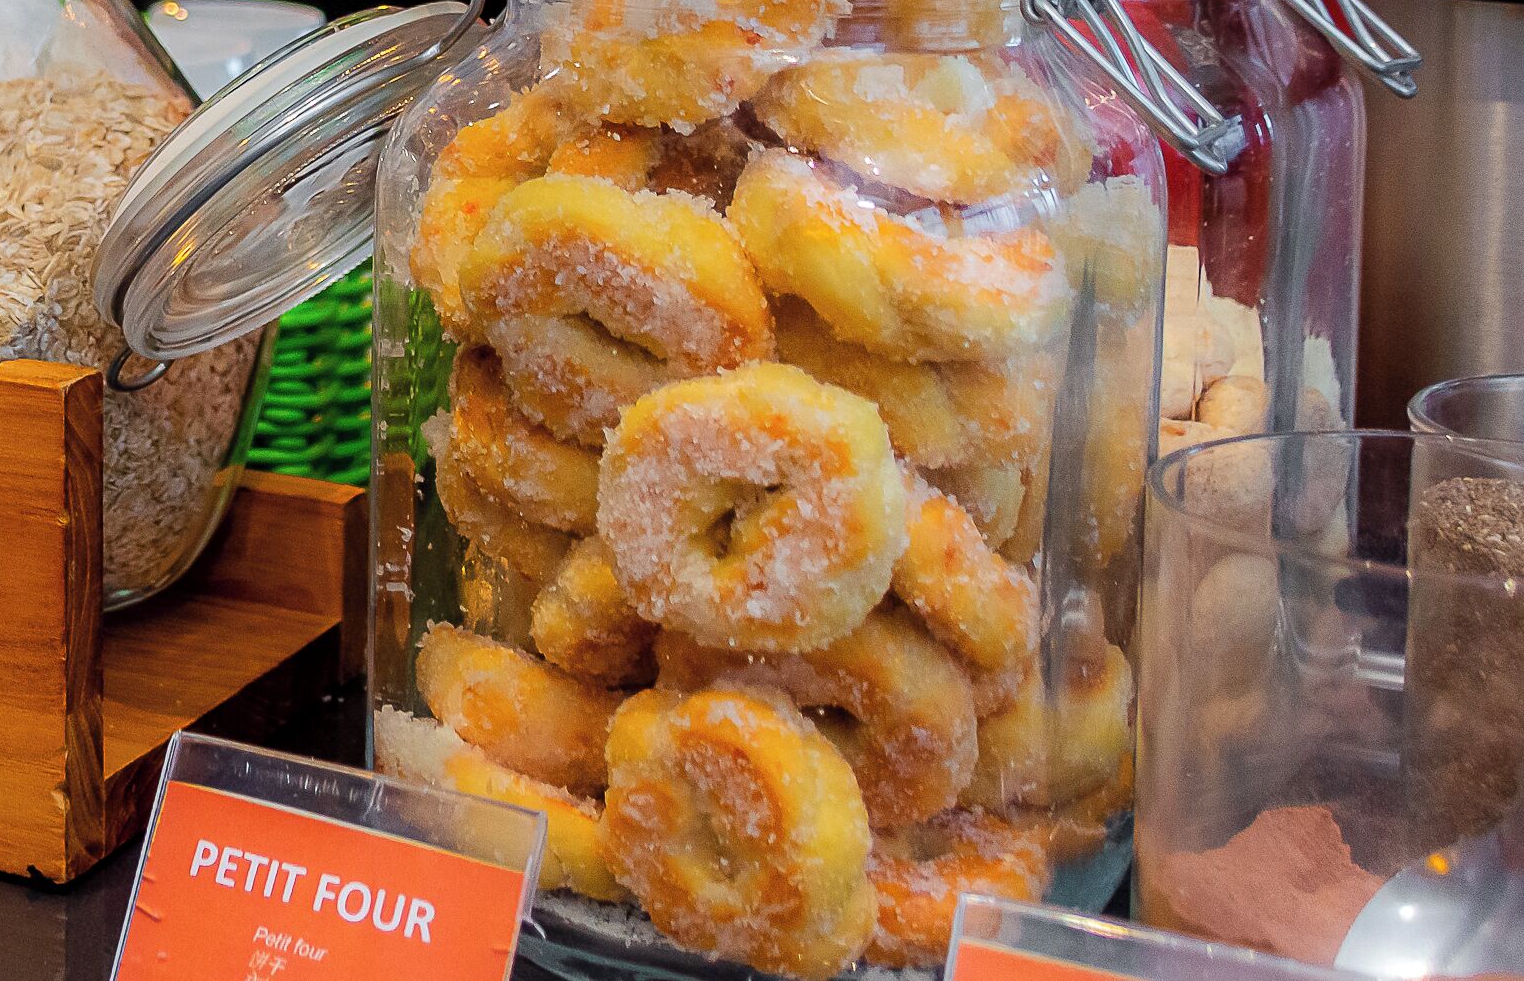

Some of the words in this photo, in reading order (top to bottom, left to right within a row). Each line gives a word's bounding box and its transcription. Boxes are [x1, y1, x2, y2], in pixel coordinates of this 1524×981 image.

[189, 838, 308, 904] PETIT
[312, 872, 436, 944] FOUR
[252, 925, 293, 952] Petit
[293, 937, 329, 962] four
